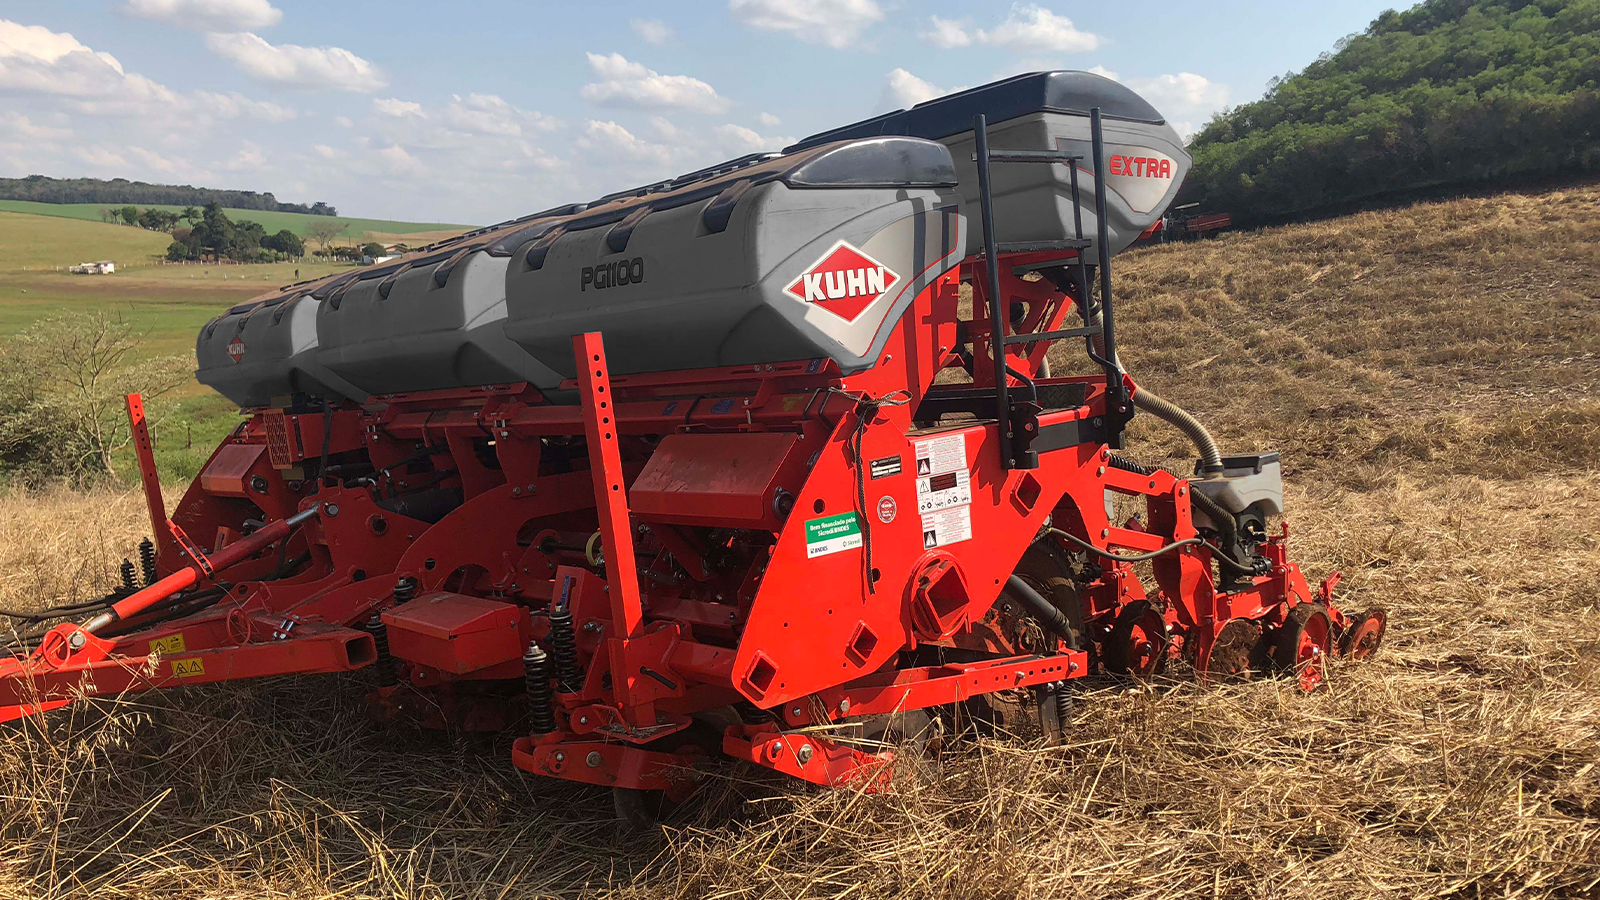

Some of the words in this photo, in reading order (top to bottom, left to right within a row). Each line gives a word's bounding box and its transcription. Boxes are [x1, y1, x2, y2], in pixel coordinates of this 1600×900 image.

[1110, 155, 1171, 178] EXTRA
[581, 257, 643, 291] PG1100
[802, 265, 885, 302] KUHN
[229, 343, 245, 355] KUHN
